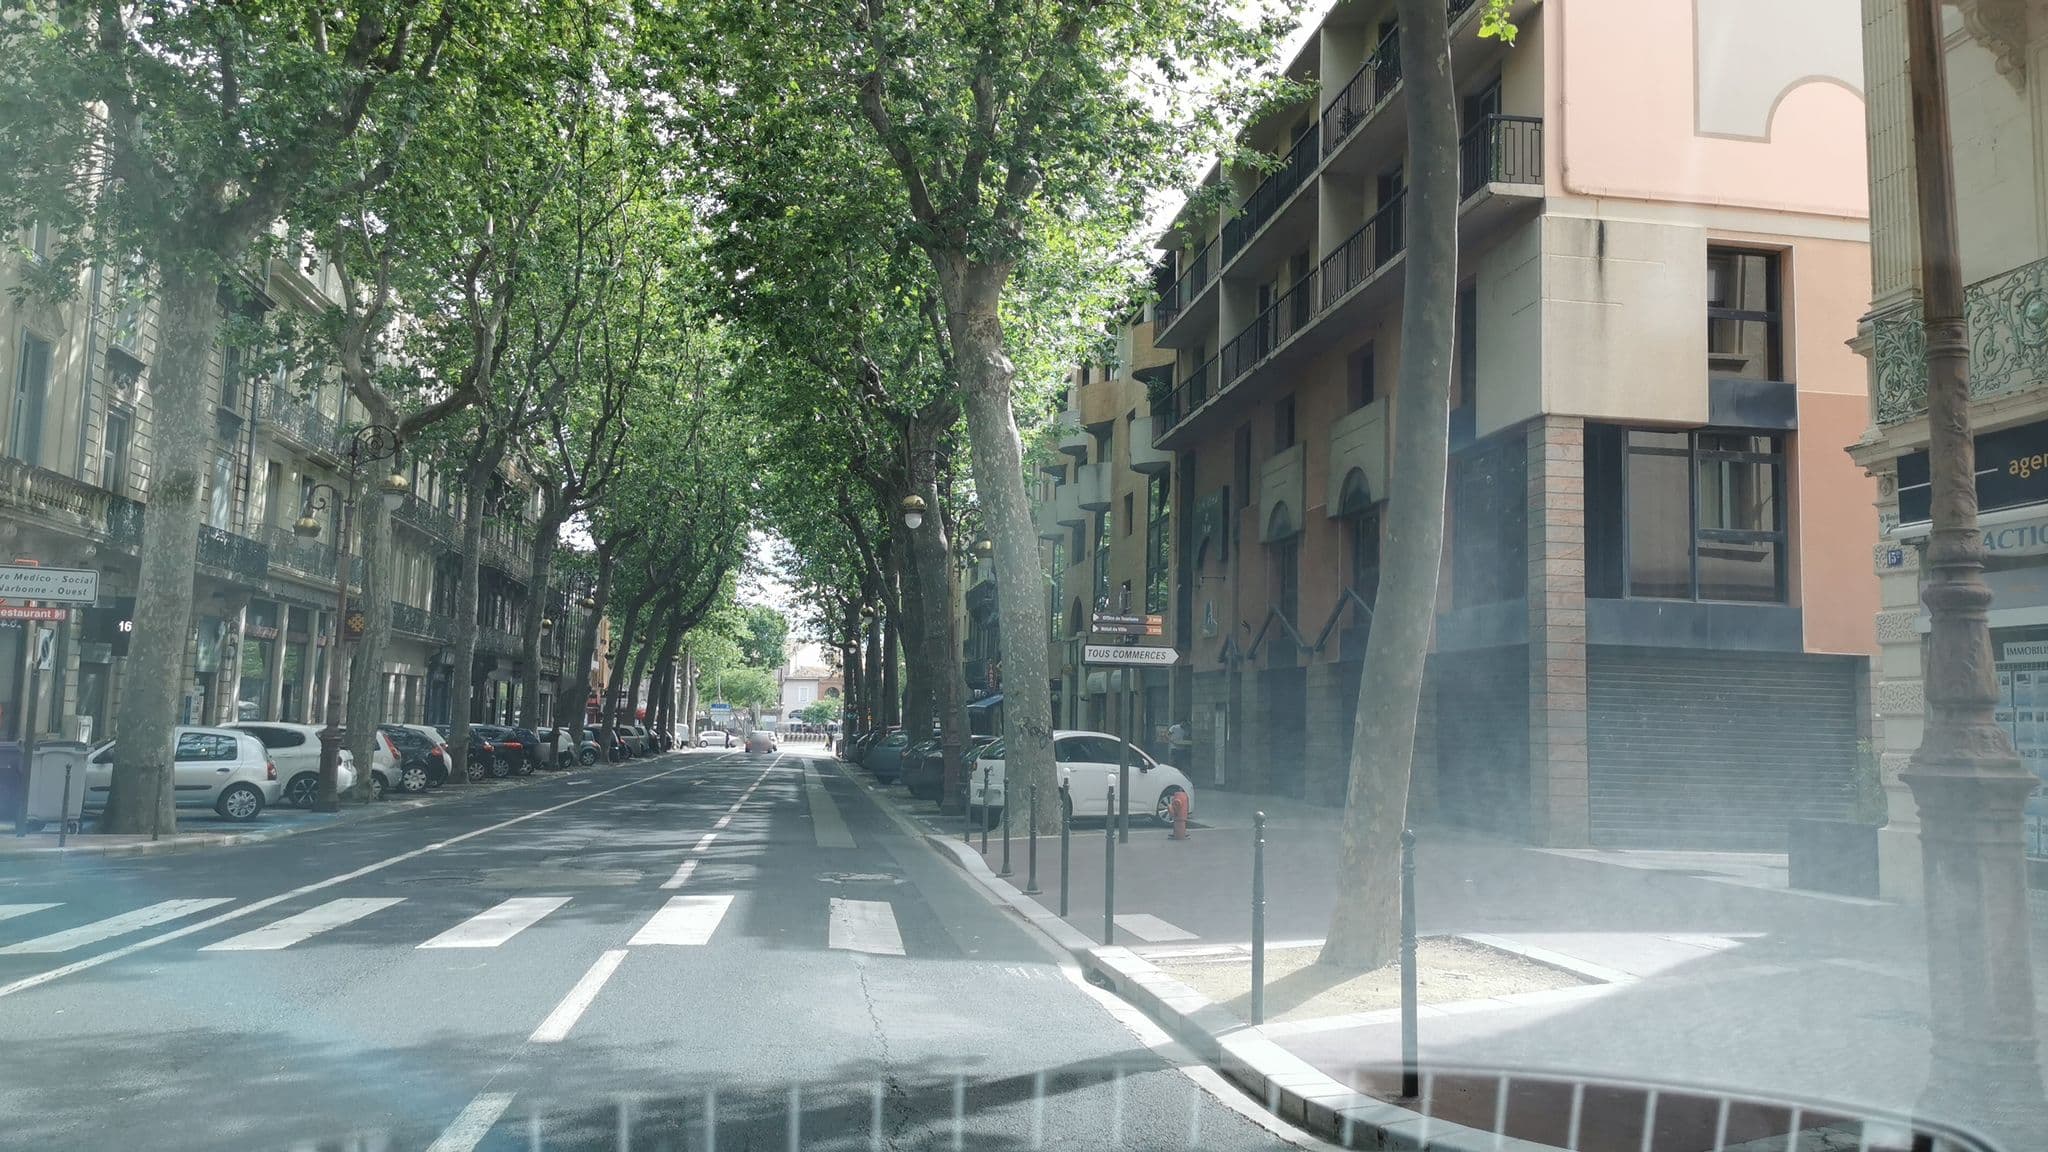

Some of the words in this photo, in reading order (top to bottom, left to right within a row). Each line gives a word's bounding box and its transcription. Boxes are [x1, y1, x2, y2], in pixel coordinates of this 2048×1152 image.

[13, 572, 52, 583] Medico
[61, 575, 94, 585] Social
[57, 586, 88, 596] Ouest
[118, 620, 133, 632] 16
[1087, 648, 1110, 658] TOUS
[1112, 649, 1167, 660] COMMERCES
[2006, 645, 2048, 657] IMMOBILI
